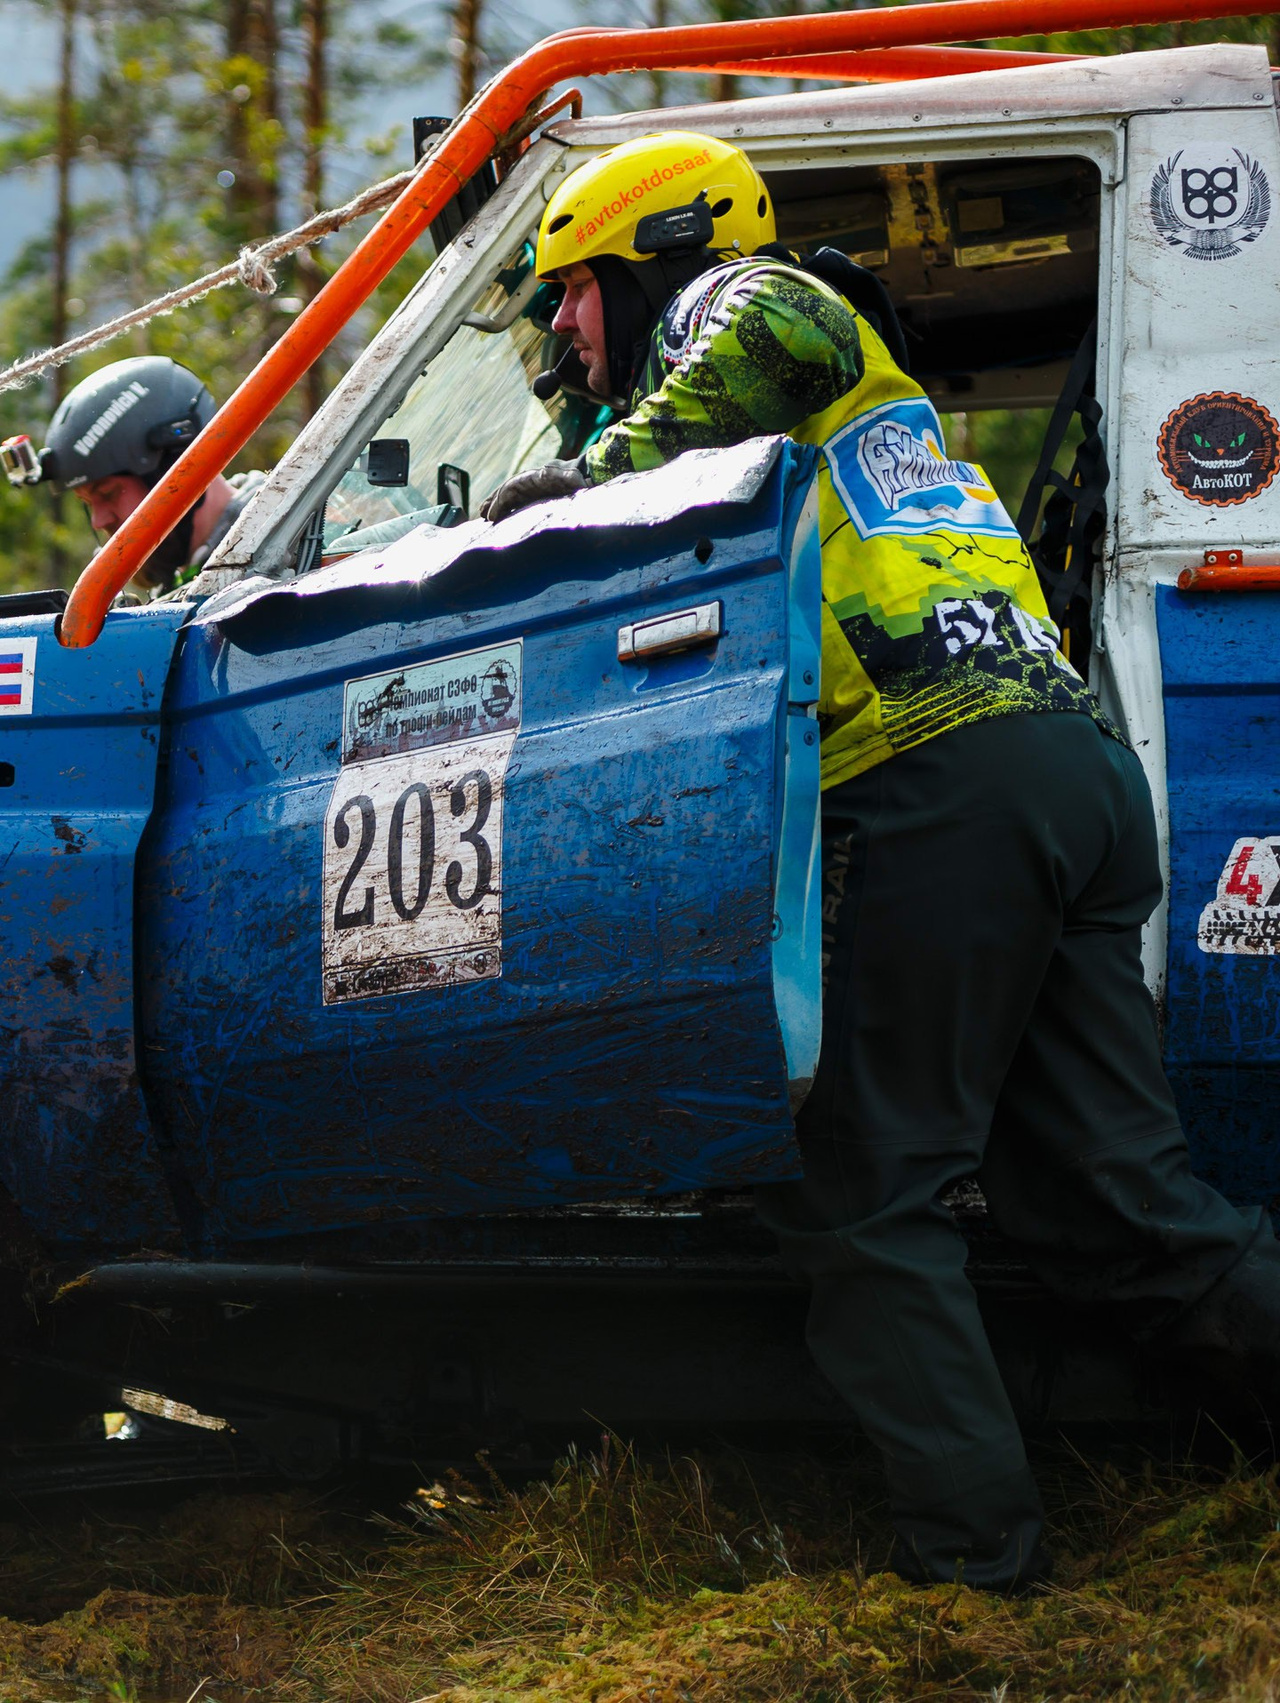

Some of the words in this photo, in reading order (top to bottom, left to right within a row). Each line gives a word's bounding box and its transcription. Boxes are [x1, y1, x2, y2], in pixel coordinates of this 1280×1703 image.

[574, 150, 713, 246] #avtokotdosaaf
[73, 390, 140, 457] Voronovich
[333, 769, 493, 930] 203
